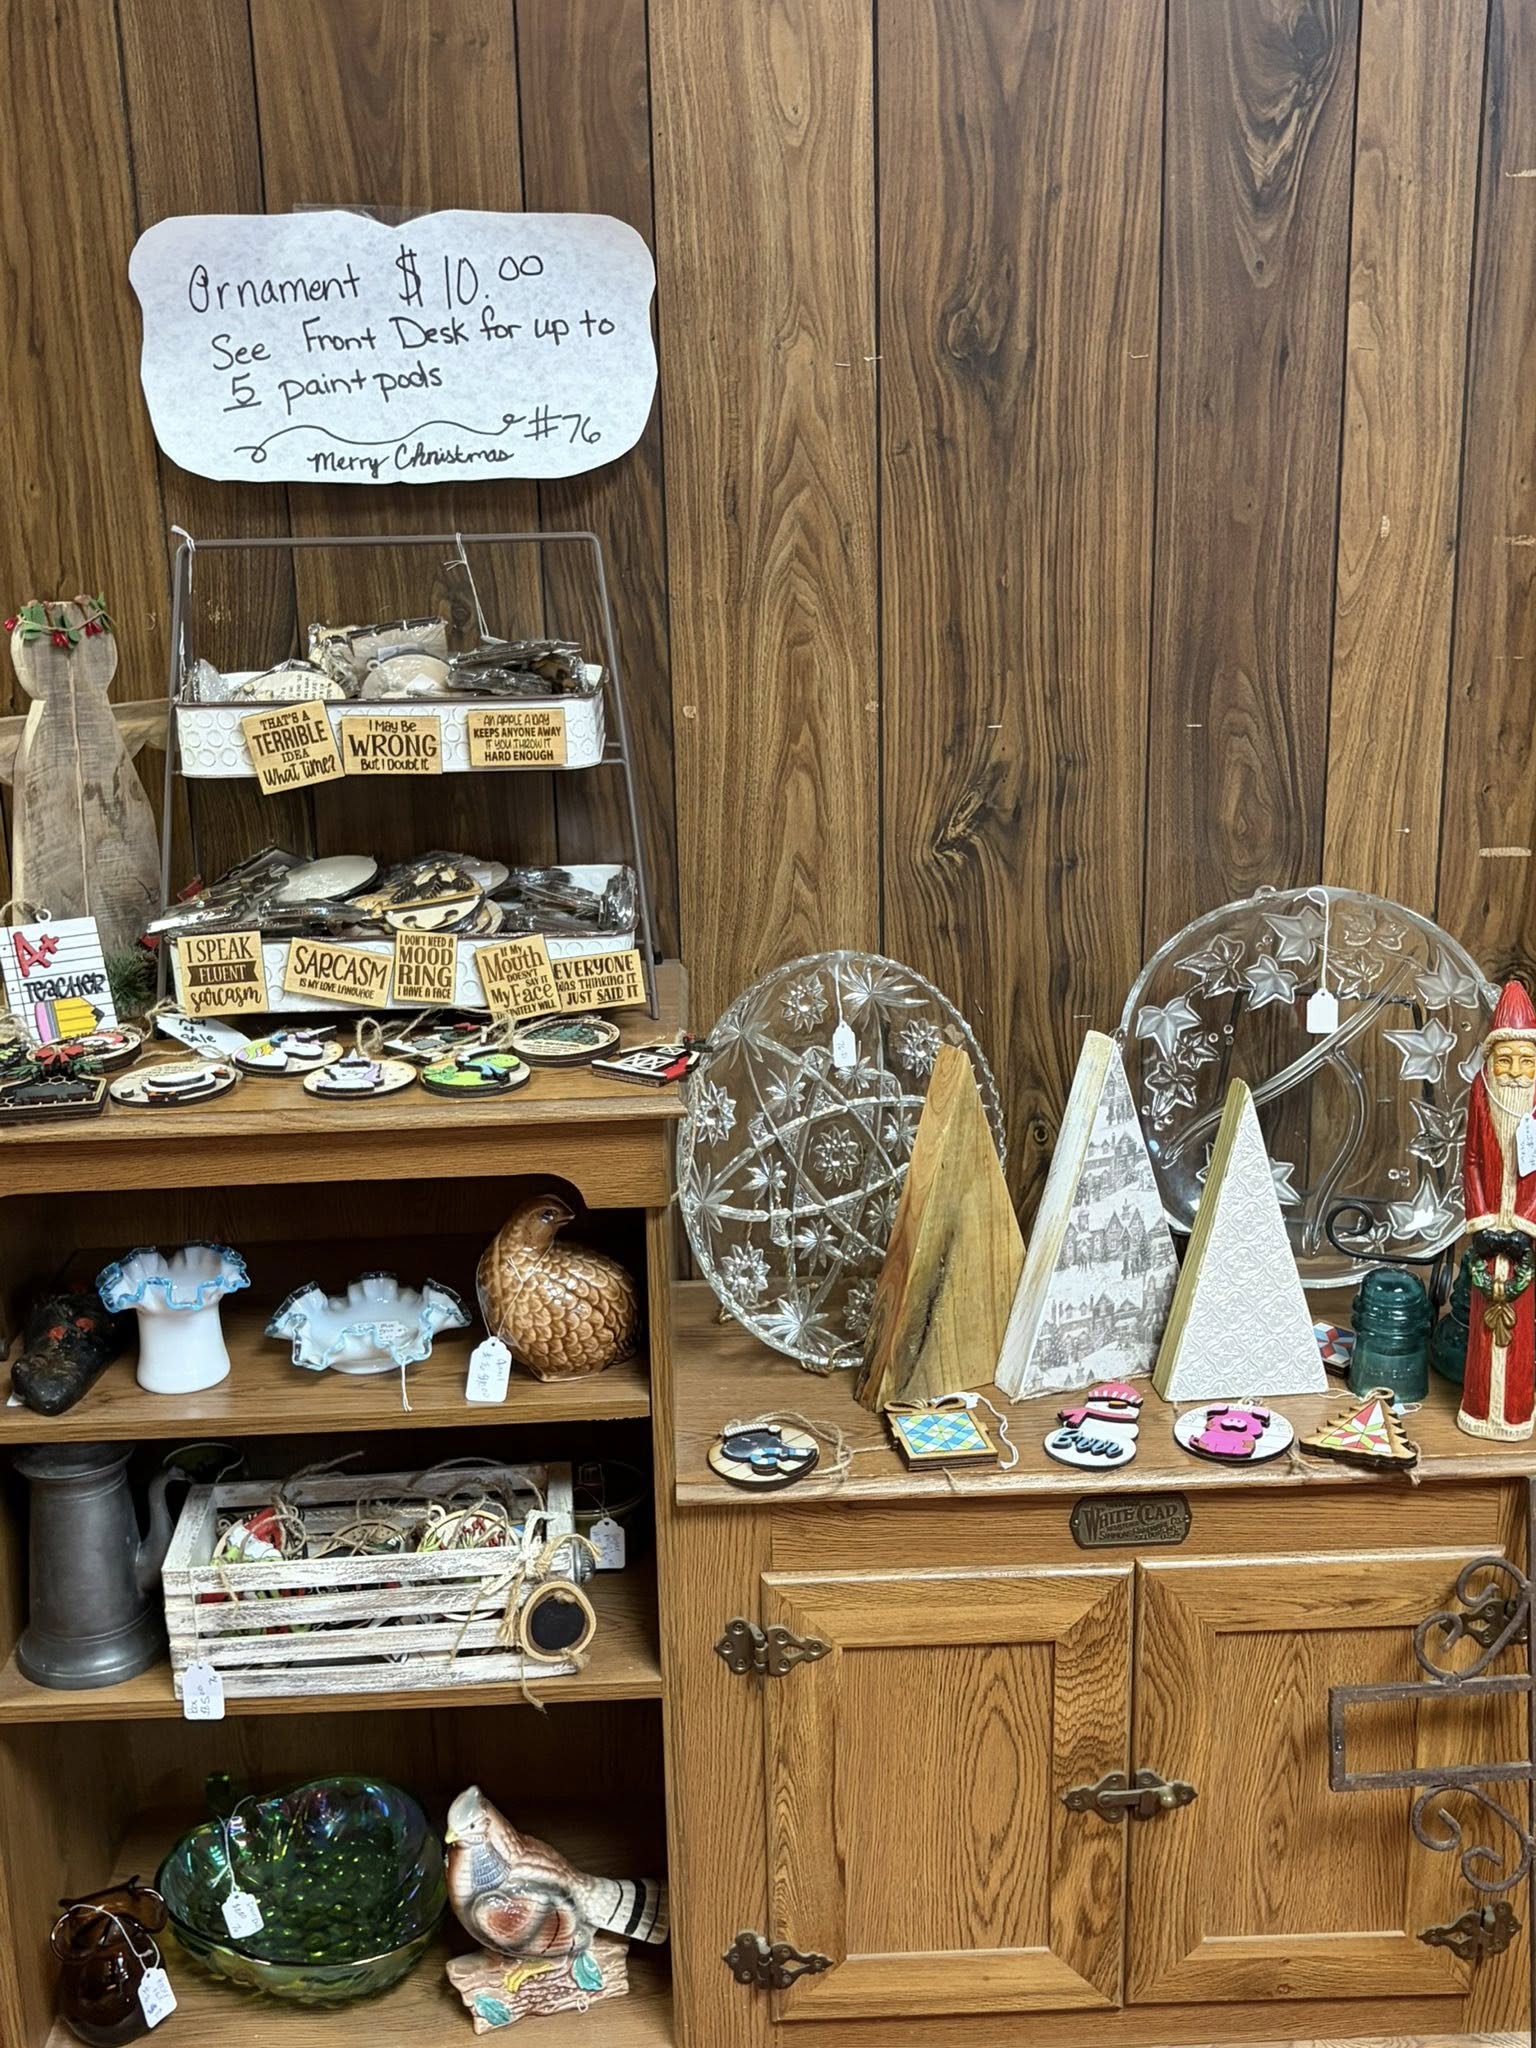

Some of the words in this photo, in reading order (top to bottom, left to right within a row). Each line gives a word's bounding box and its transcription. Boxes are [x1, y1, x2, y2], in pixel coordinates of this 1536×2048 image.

[188, 263, 360, 313] Ornament
[211, 333, 271, 370] See
[302, 316, 376, 352] Front
[389, 316, 469, 349] Desk
[480, 304, 521, 341] for
[534, 318, 570, 346] up
[579, 309, 615, 338] to
[230, 372, 256, 407] 5
[278, 369, 366, 415] paint
[372, 360, 442, 403] pods
[524, 404, 601, 444] #76
[307, 451, 390, 479] Merry
[394, 441, 514, 470] Christmas
[260, 712, 299, 731] THAT'S
[302, 710, 311, 721] A
[369, 719, 373, 732] I
[375, 719, 398, 733] May
[401, 720, 417, 733] Be
[497, 713, 522, 726] APPLE
[524, 714, 531, 725] A
[532, 713, 550, 725] DAY
[252, 720, 328, 756] TERRIBLE
[473, 727, 500, 738] KEEPS
[501, 727, 536, 737] ANYONE
[537, 726, 562, 737] AWAY
[347, 734, 437, 757] WRONG
[494, 739, 512, 750] YOU
[513, 738, 542, 749] THROW
[543, 738, 552, 748] IT
[281, 748, 310, 763] IDEA
[360, 758, 380, 771] But
[381, 758, 385, 770] I
[387, 758, 419, 771] Doubt
[421, 758, 430, 770] It
[484, 751, 512, 762] HARD
[513, 750, 554, 761] ENOUGH
[263, 763, 300, 786] What
[185, 941, 193, 963] I
[196, 936, 254, 962] SPEAK
[428, 936, 447, 947] NEED
[448, 937, 454, 948] A
[509, 944, 522, 955] My
[13, 931, 59, 977] A+
[399, 946, 454, 966] MOOD
[481, 945, 545, 984] Mouth
[199, 964, 246, 983] FLUENT
[294, 945, 388, 990] SARCASM
[398, 964, 452, 988] RING
[553, 954, 634, 980] EVERYONE
[299, 978, 306, 987] IS
[307, 979, 320, 990] MY
[320, 981, 337, 993] LOVE
[337, 984, 375, 1000] LANGUAGE
[525, 977, 540, 987] SAY
[540, 975, 548, 983] IT
[555, 980, 576, 992] WAS
[626, 972, 636, 984] IT
[190, 986, 262, 1013] sarcasm
[397, 986, 401, 996] I
[402, 986, 423, 997] HAVE
[424, 987, 431, 998] A
[432, 987, 451, 999] FACE
[490, 988, 511, 1008] My
[509, 983, 554, 1006] Face
[567, 990, 592, 1006] JUST
[597, 986, 624, 1001] SAID
[627, 984, 638, 998] IT
[537, 999, 557, 1010] WILL
[1136, 1503, 1179, 1525] CLAD
